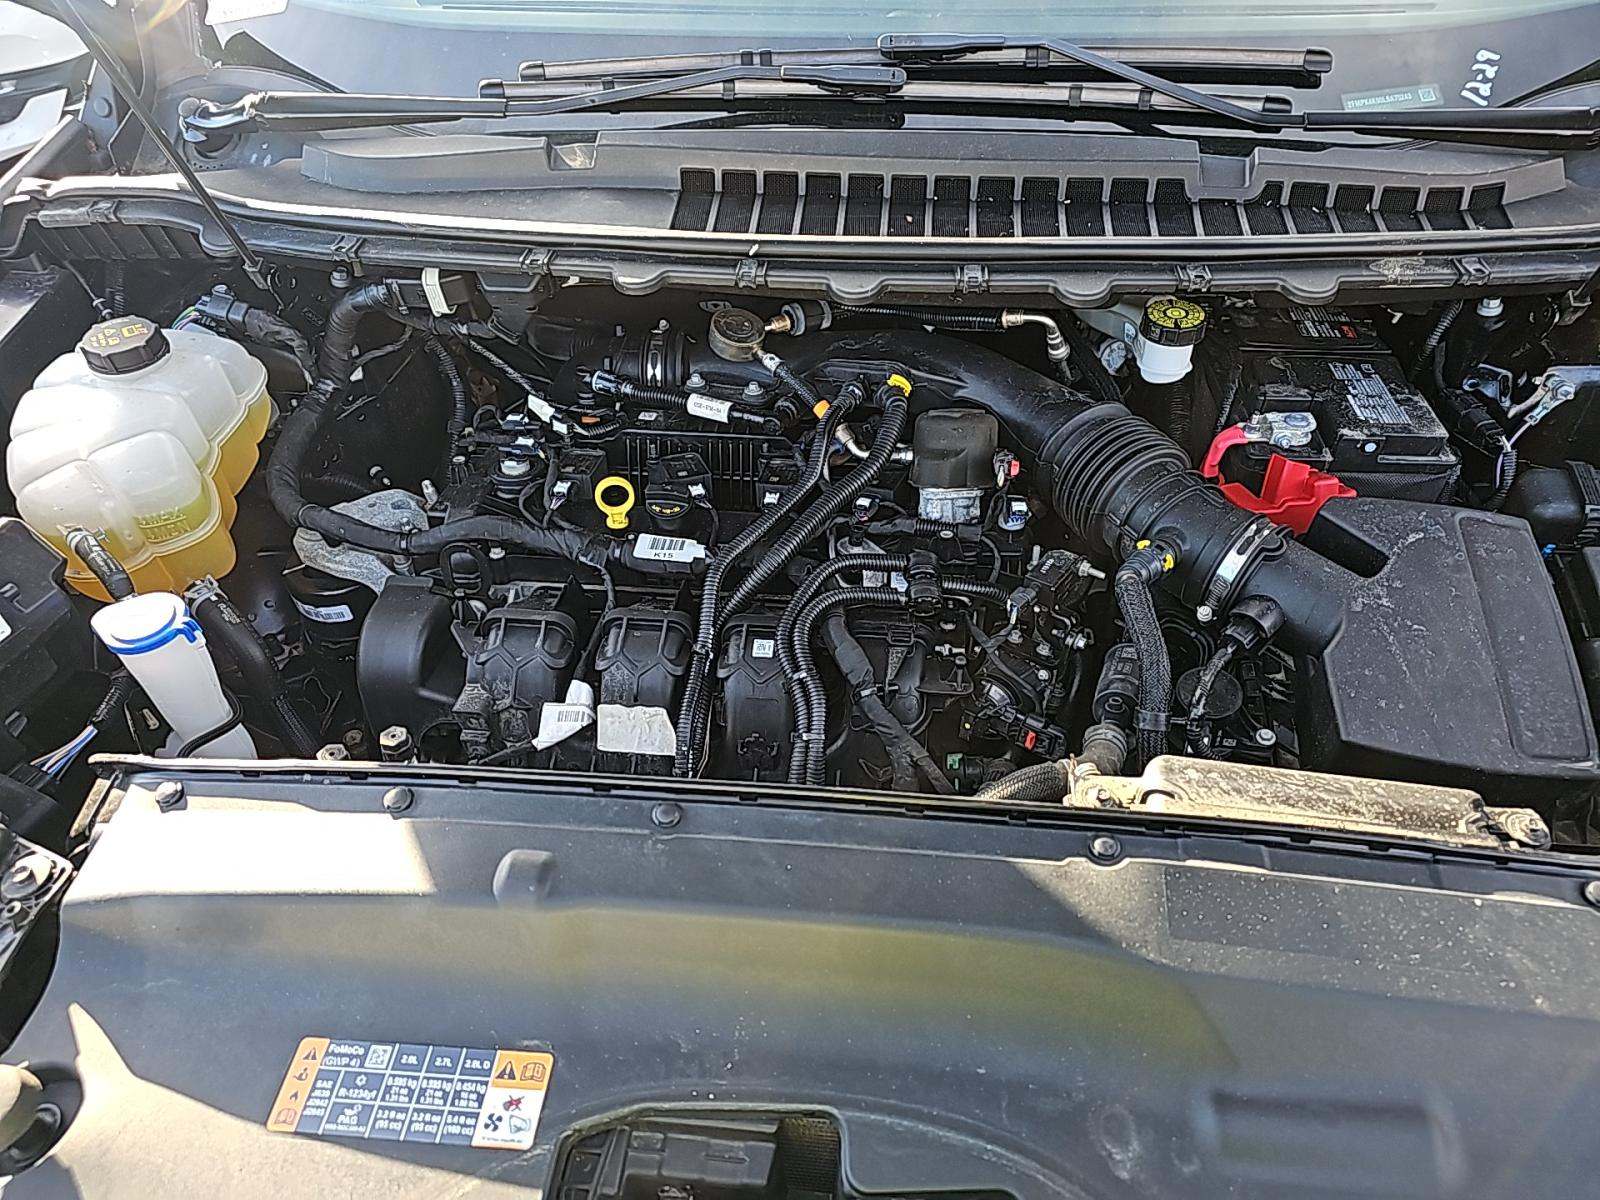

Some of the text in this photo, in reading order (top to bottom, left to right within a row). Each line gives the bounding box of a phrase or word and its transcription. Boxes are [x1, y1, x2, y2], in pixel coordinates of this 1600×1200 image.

[653, 551, 674, 559] K15
[328, 1043, 365, 1056] FoMoCo
[336, 1114, 358, 1125] PAG
